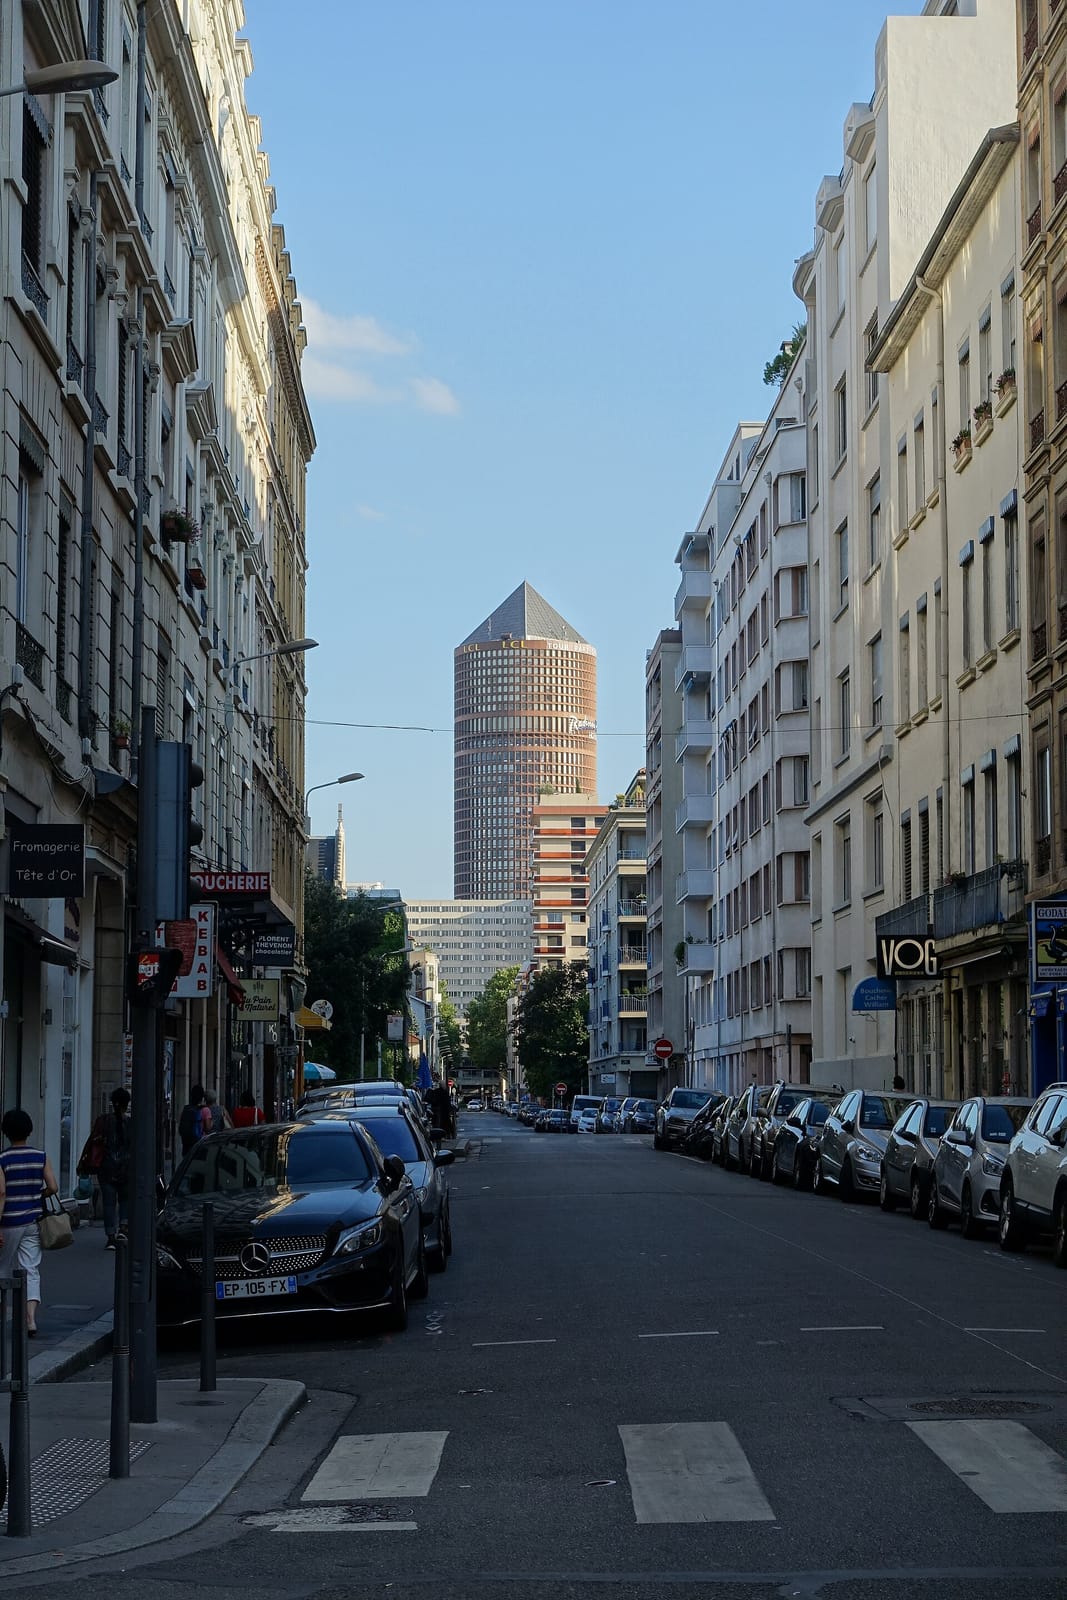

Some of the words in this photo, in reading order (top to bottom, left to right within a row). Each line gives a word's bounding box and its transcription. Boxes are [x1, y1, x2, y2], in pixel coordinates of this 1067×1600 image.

[463, 644, 480, 653] LCL
[502, 640, 526, 649] LCL
[13, 840, 81, 855] Fromagerie
[16, 869, 44, 881] Tête
[47, 869, 76, 881] d'Or
[190, 875, 269, 890] OUCHERIE
[197, 911, 209, 991] KEBAB
[881, 938, 938, 976] VOG
[252, 995, 272, 1004] Pain
[245, 1003, 276, 1012] Naturel
